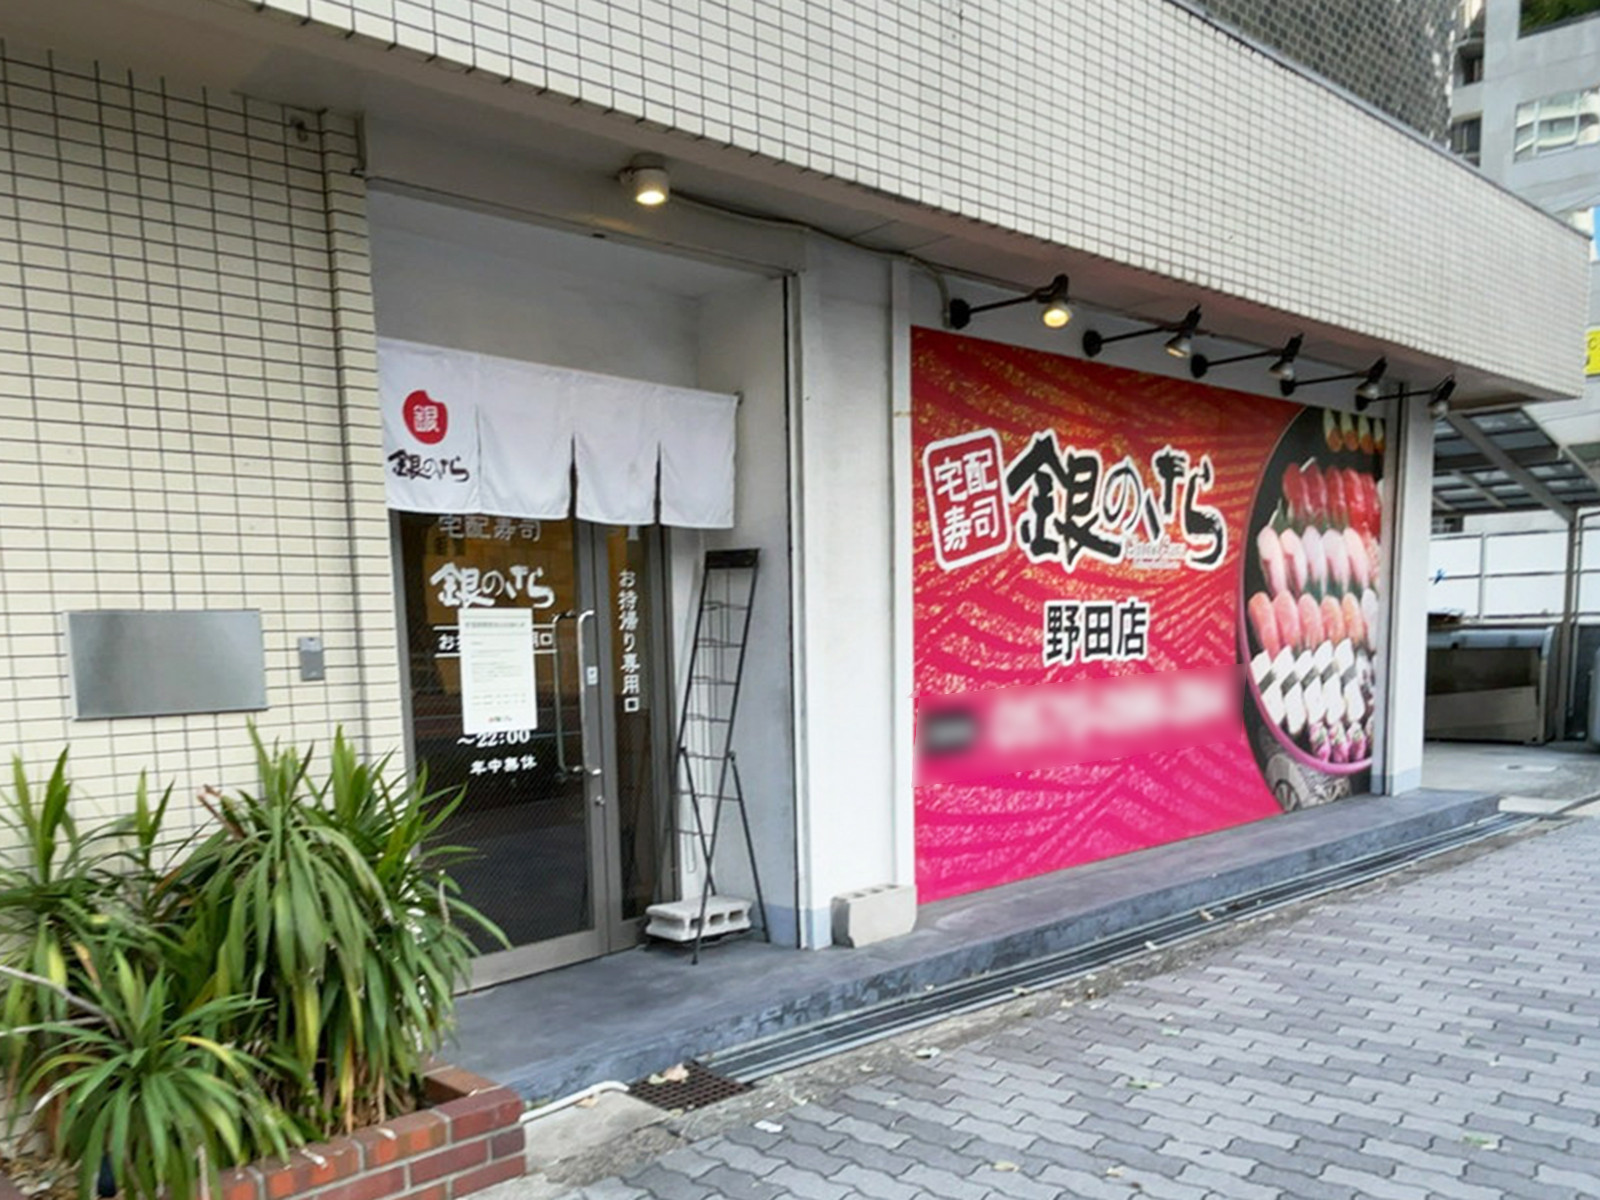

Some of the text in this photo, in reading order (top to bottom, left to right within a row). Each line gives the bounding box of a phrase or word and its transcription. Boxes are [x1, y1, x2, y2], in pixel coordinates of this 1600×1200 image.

[388, 449, 469, 482] 銀のさら
[933, 447, 999, 503] 宅配
[943, 495, 1000, 552] 寿司
[1004, 430, 1225, 570] 銀のさら
[439, 515, 541, 541] 宅配寿司
[430, 562, 555, 609] 銀のさら
[1044, 600, 1149, 664] 野田店
[469, 754, 538, 776] 年中無休
